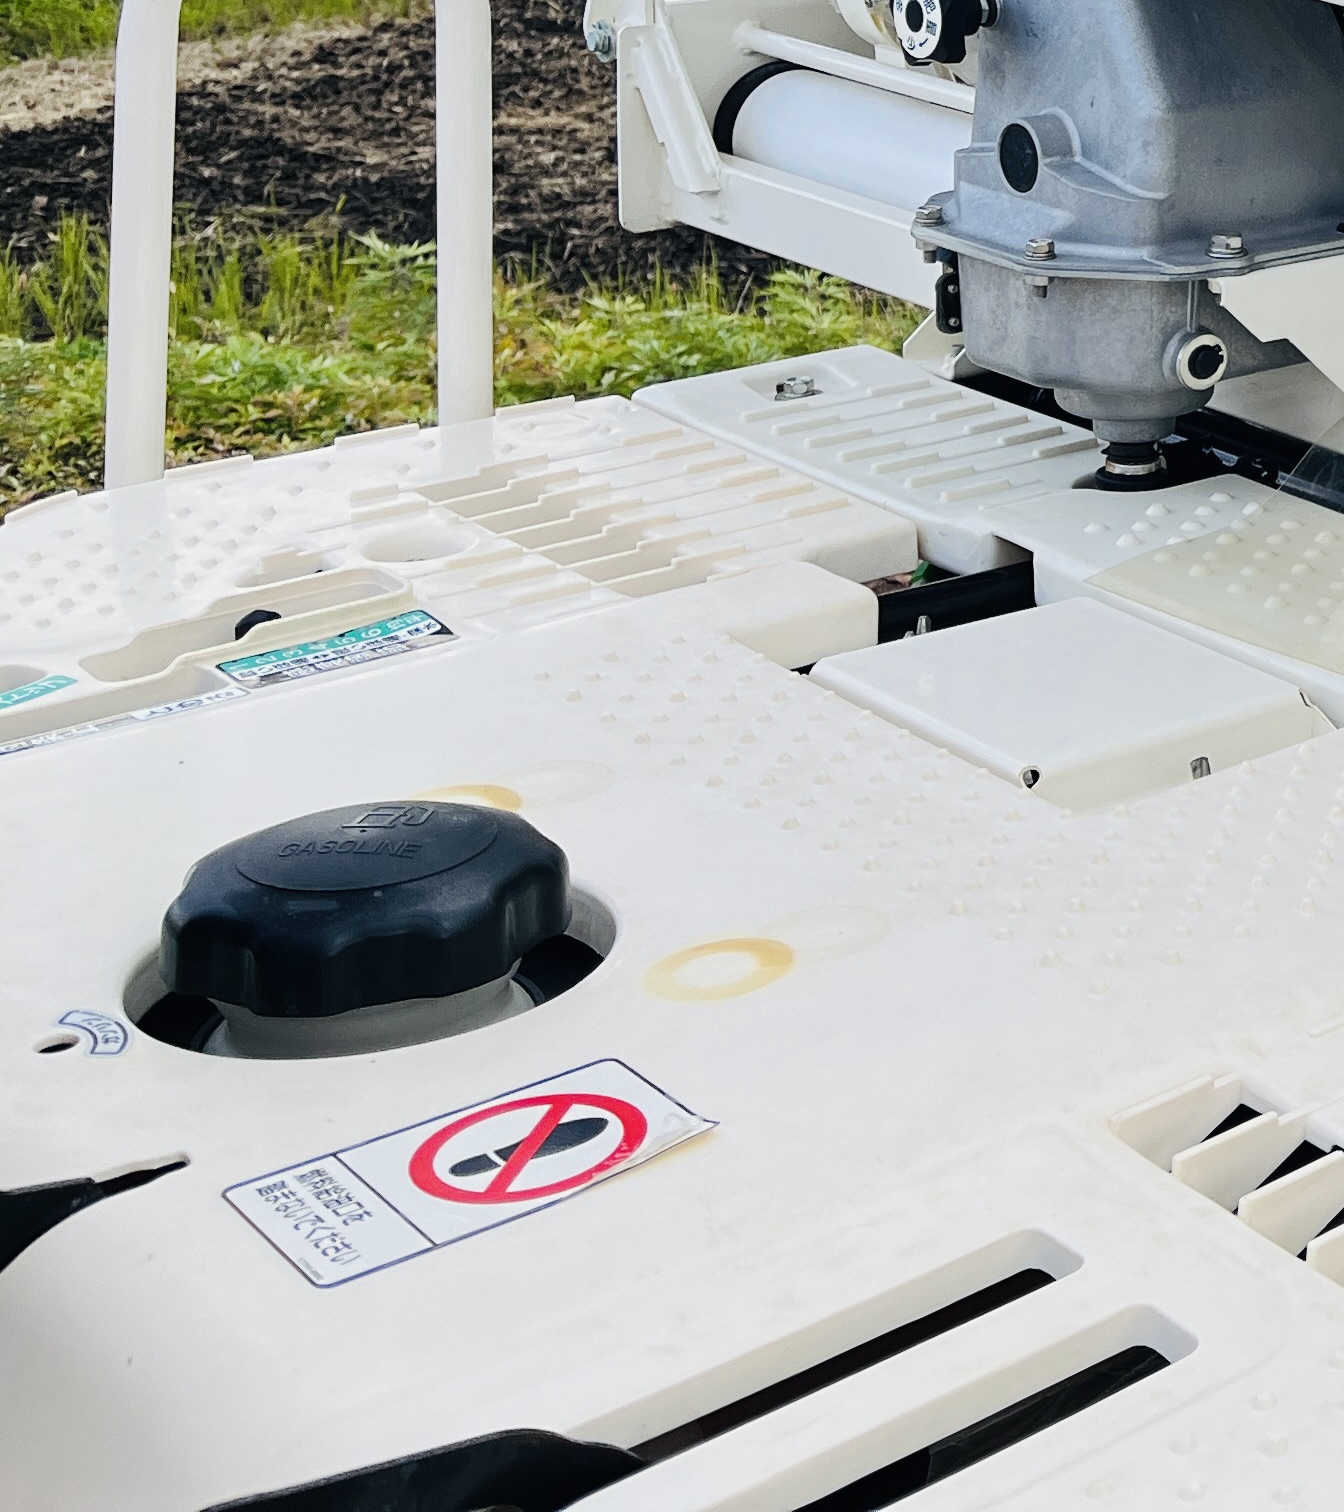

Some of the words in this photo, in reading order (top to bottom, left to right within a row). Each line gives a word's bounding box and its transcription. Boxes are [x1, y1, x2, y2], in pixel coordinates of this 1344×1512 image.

[278, 839, 423, 859] GASOLINE
[256, 1180, 361, 1265] 踏まないでください
